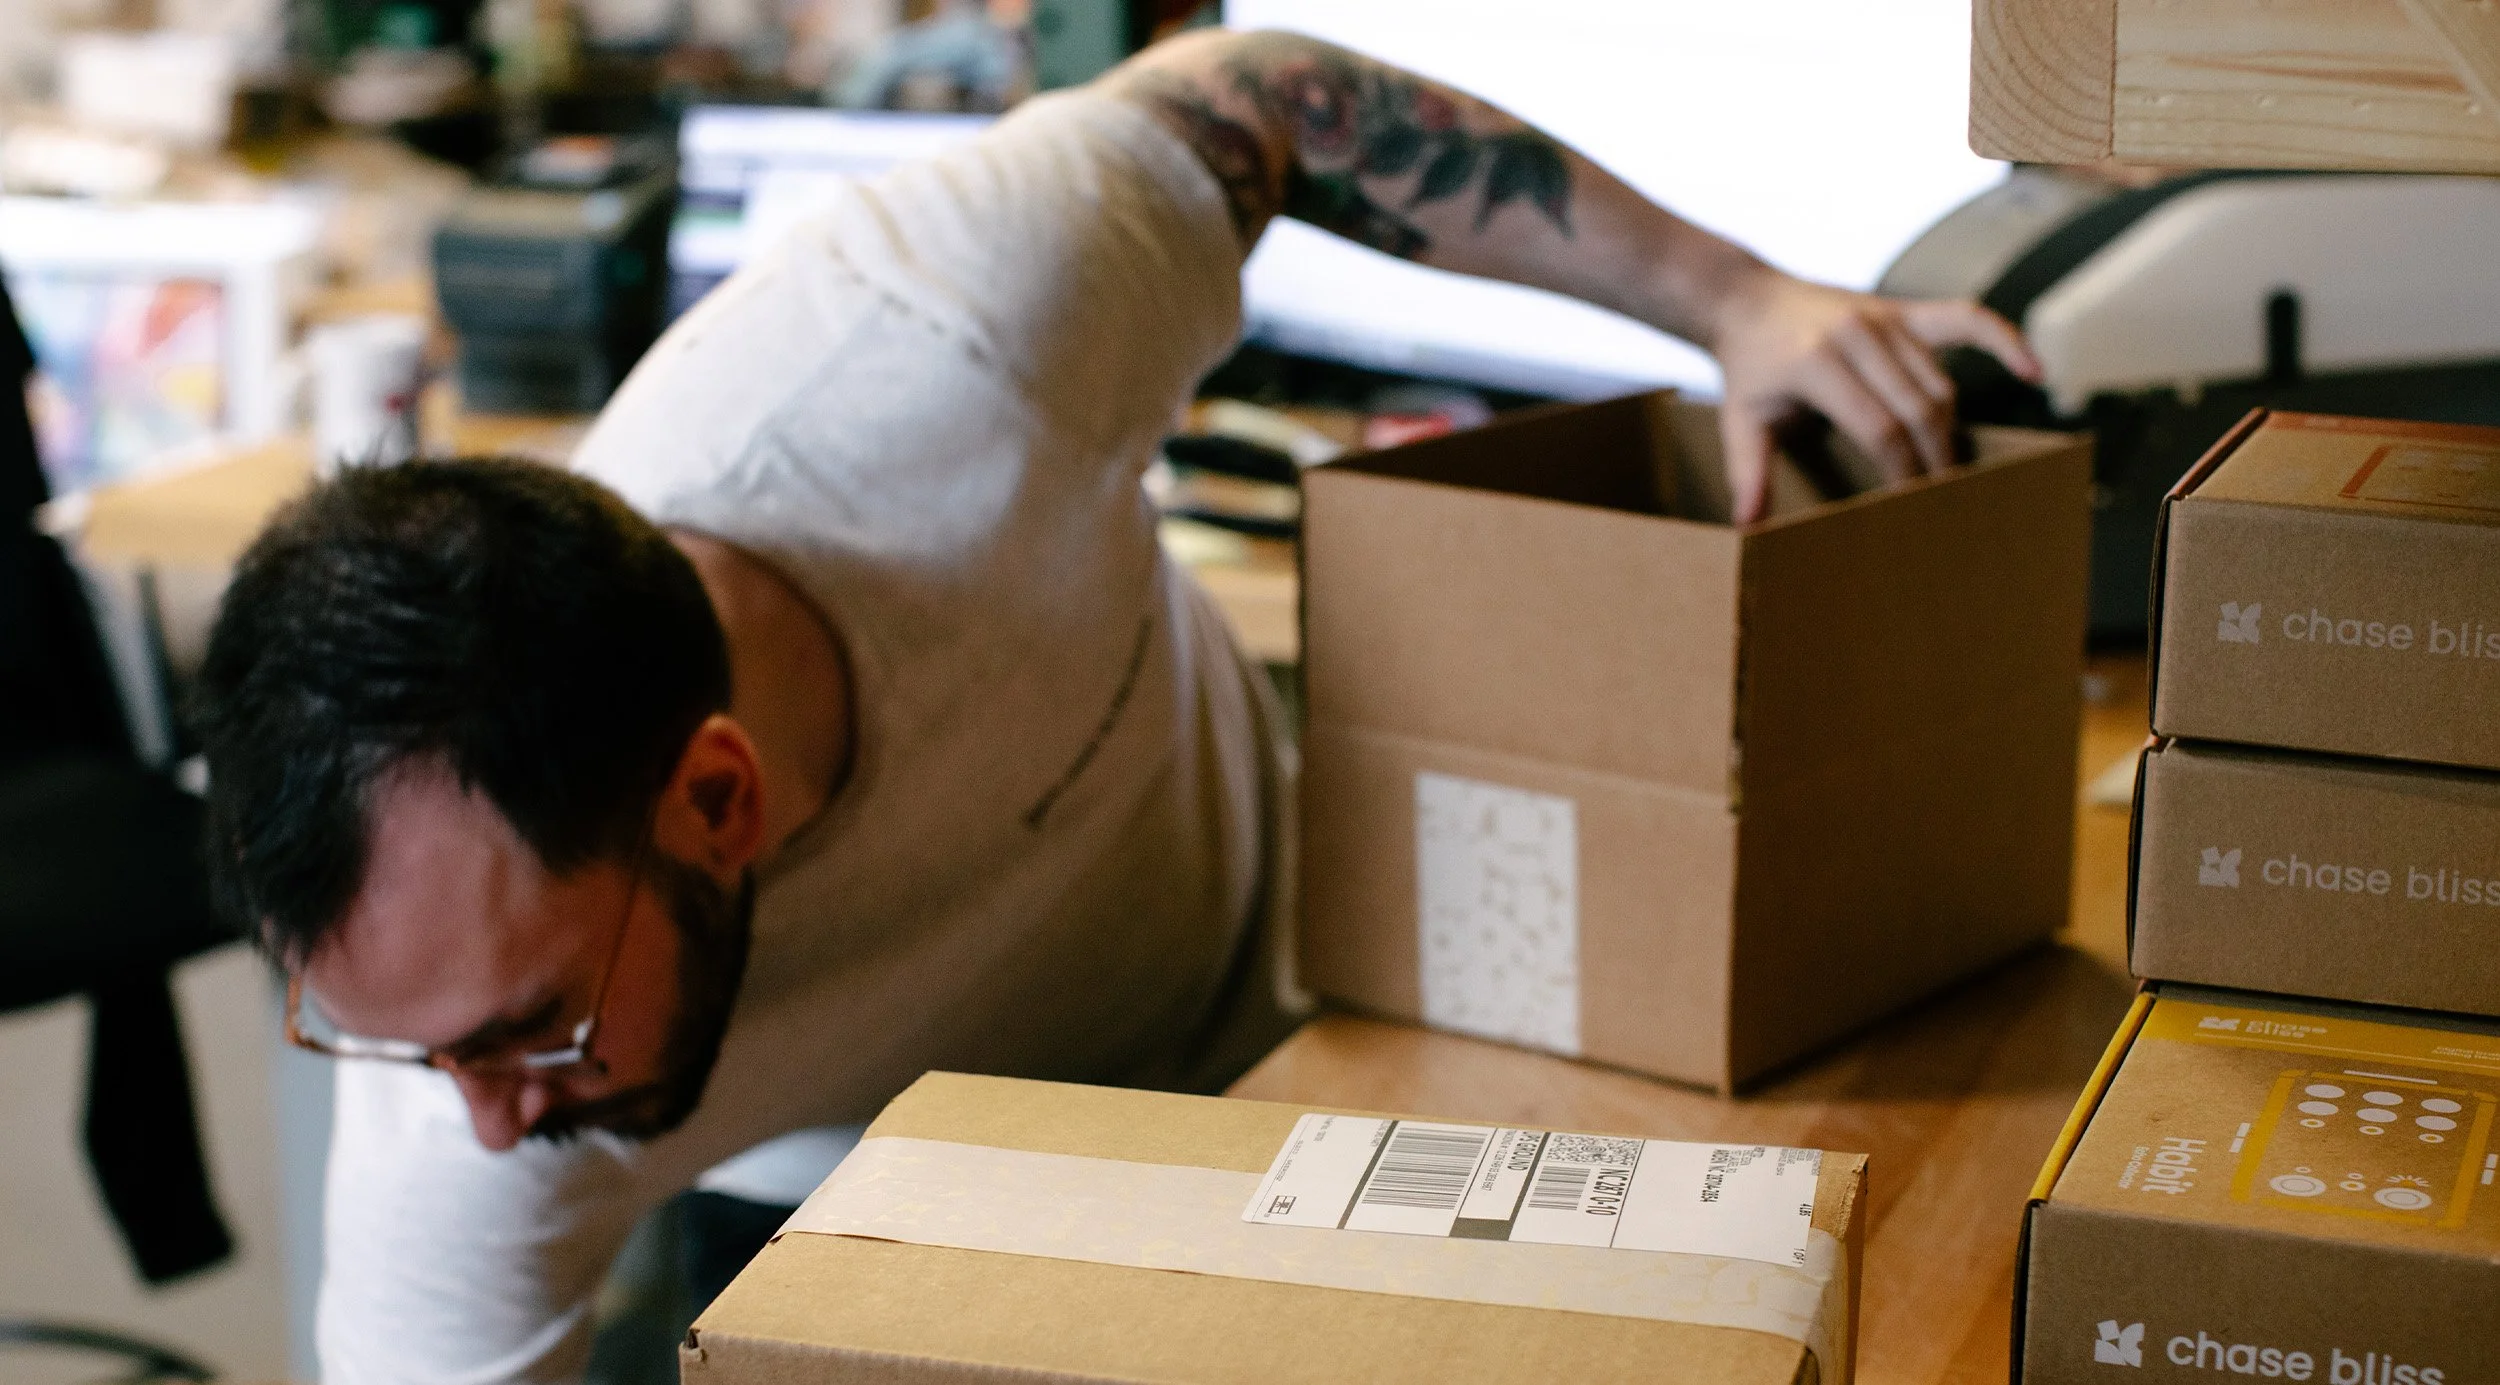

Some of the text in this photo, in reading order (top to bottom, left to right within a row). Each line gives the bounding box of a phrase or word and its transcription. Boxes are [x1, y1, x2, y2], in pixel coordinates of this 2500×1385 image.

[2282, 608, 2414, 650] chase
[2261, 854, 2500, 906] chase bliss
[1506, 1142, 1537, 1171] GROUND
[2141, 1136, 2207, 1194] Habit
[1585, 1168, 1630, 1216] NC 287 0-10
[1799, 1207, 1811, 1217] LBS
[2166, 1330, 2445, 1385] chase bliss
